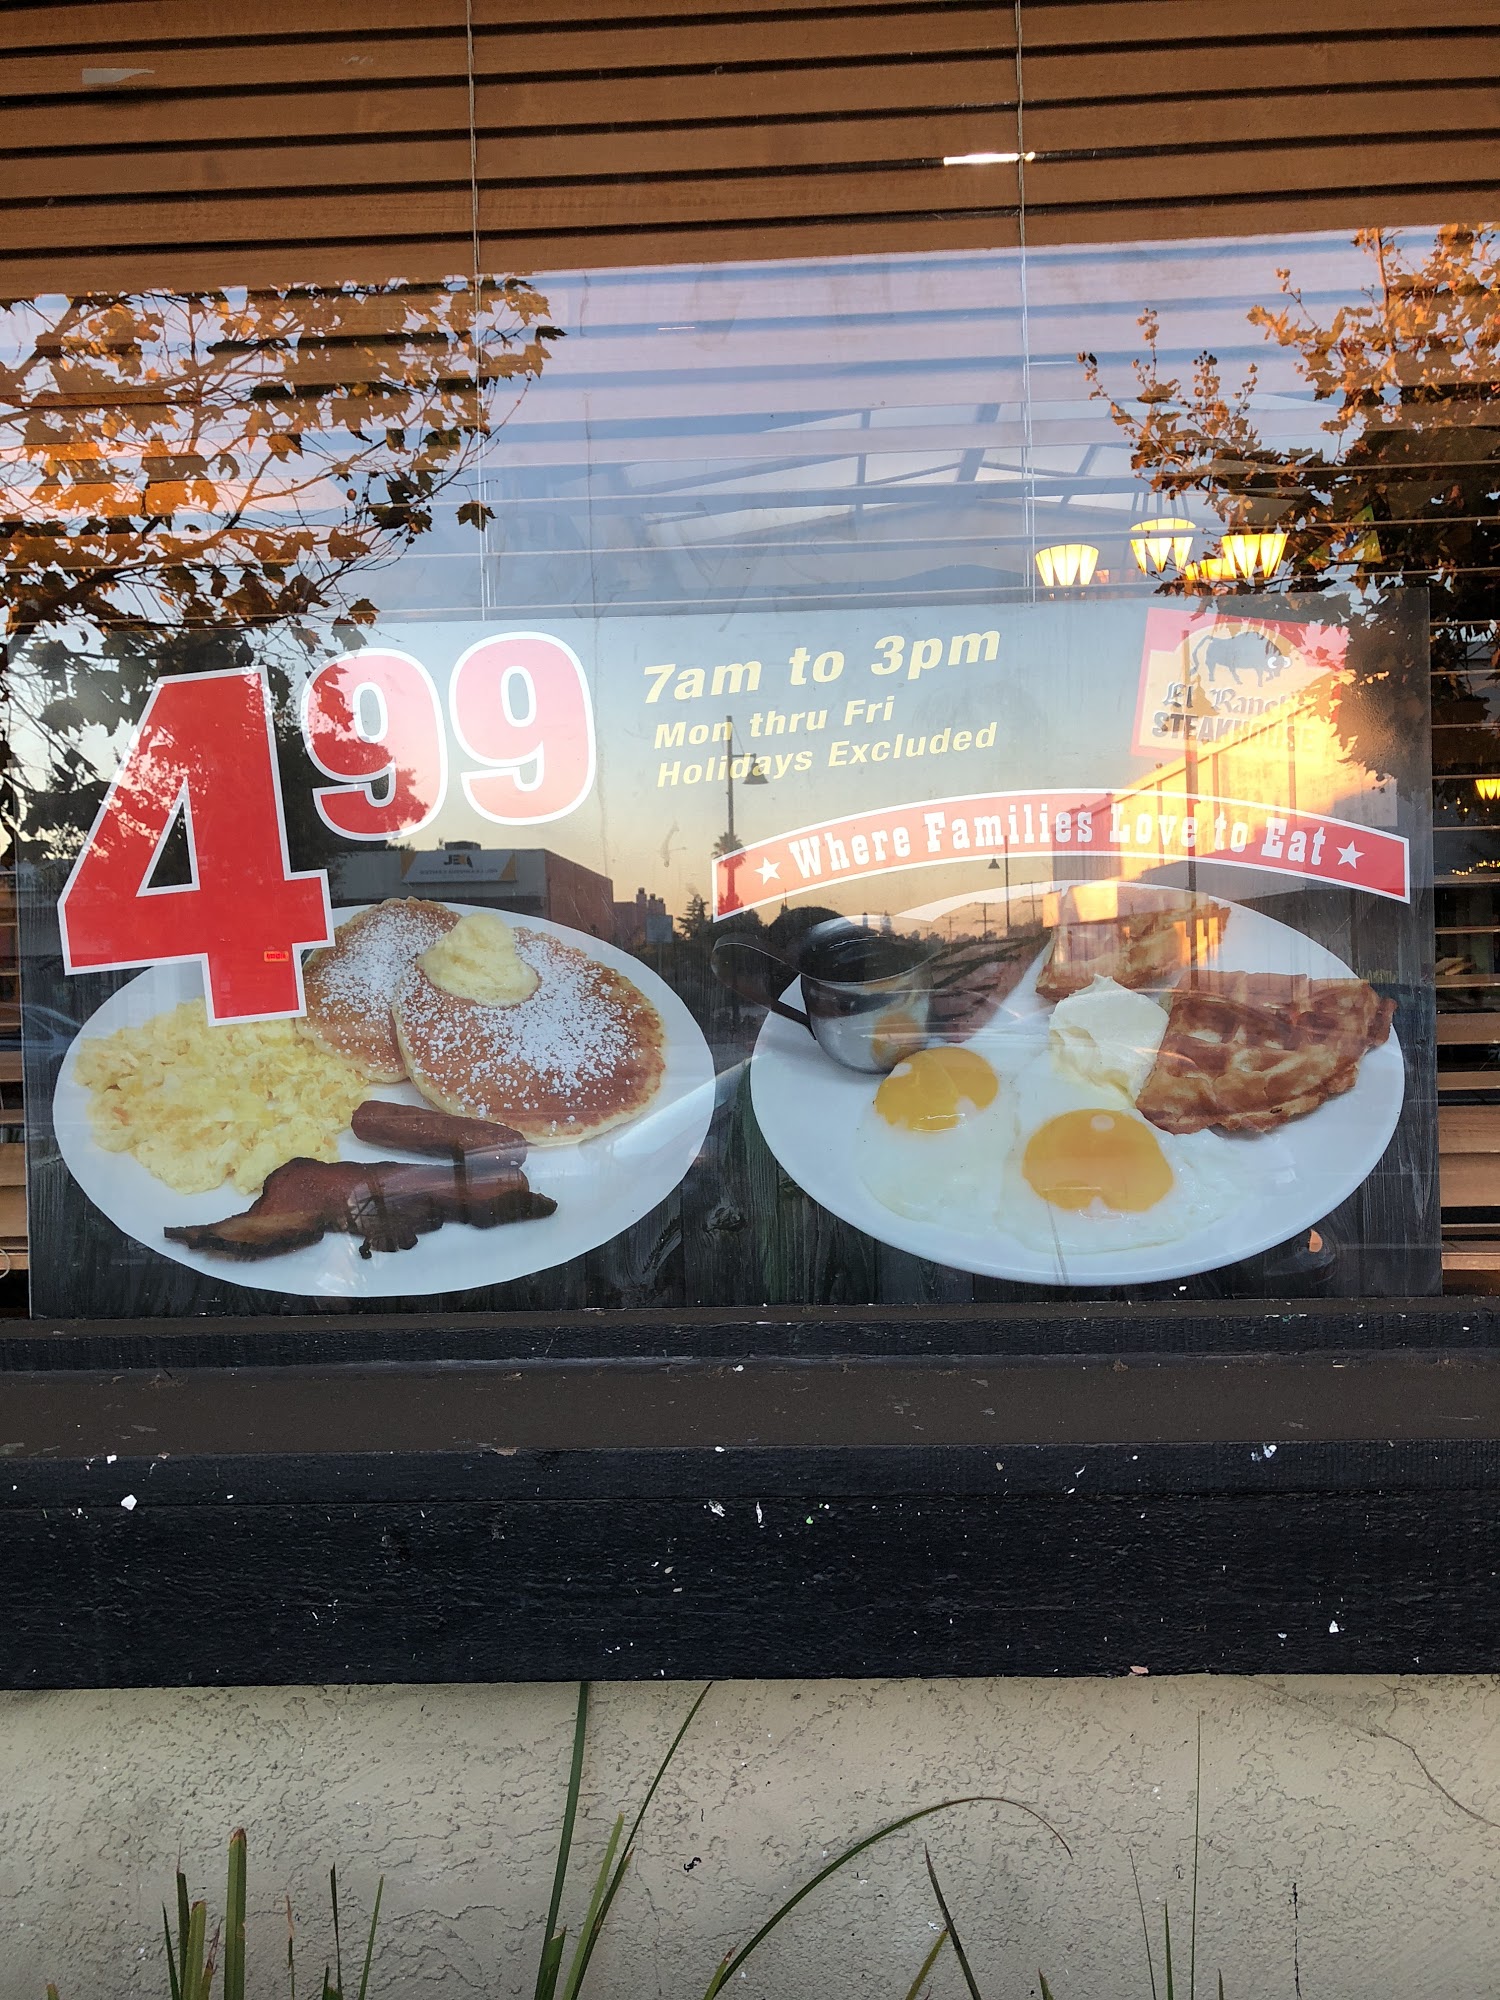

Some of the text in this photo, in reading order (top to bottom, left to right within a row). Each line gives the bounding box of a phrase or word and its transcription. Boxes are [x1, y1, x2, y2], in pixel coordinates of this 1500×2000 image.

[643, 629, 1001, 704] 7am to 3pm
[653, 695, 896, 750] Mon thru Fri
[656, 721, 998, 789] Holidays Excluded
[787, 802, 1327, 879] Where Families Love to Eat
